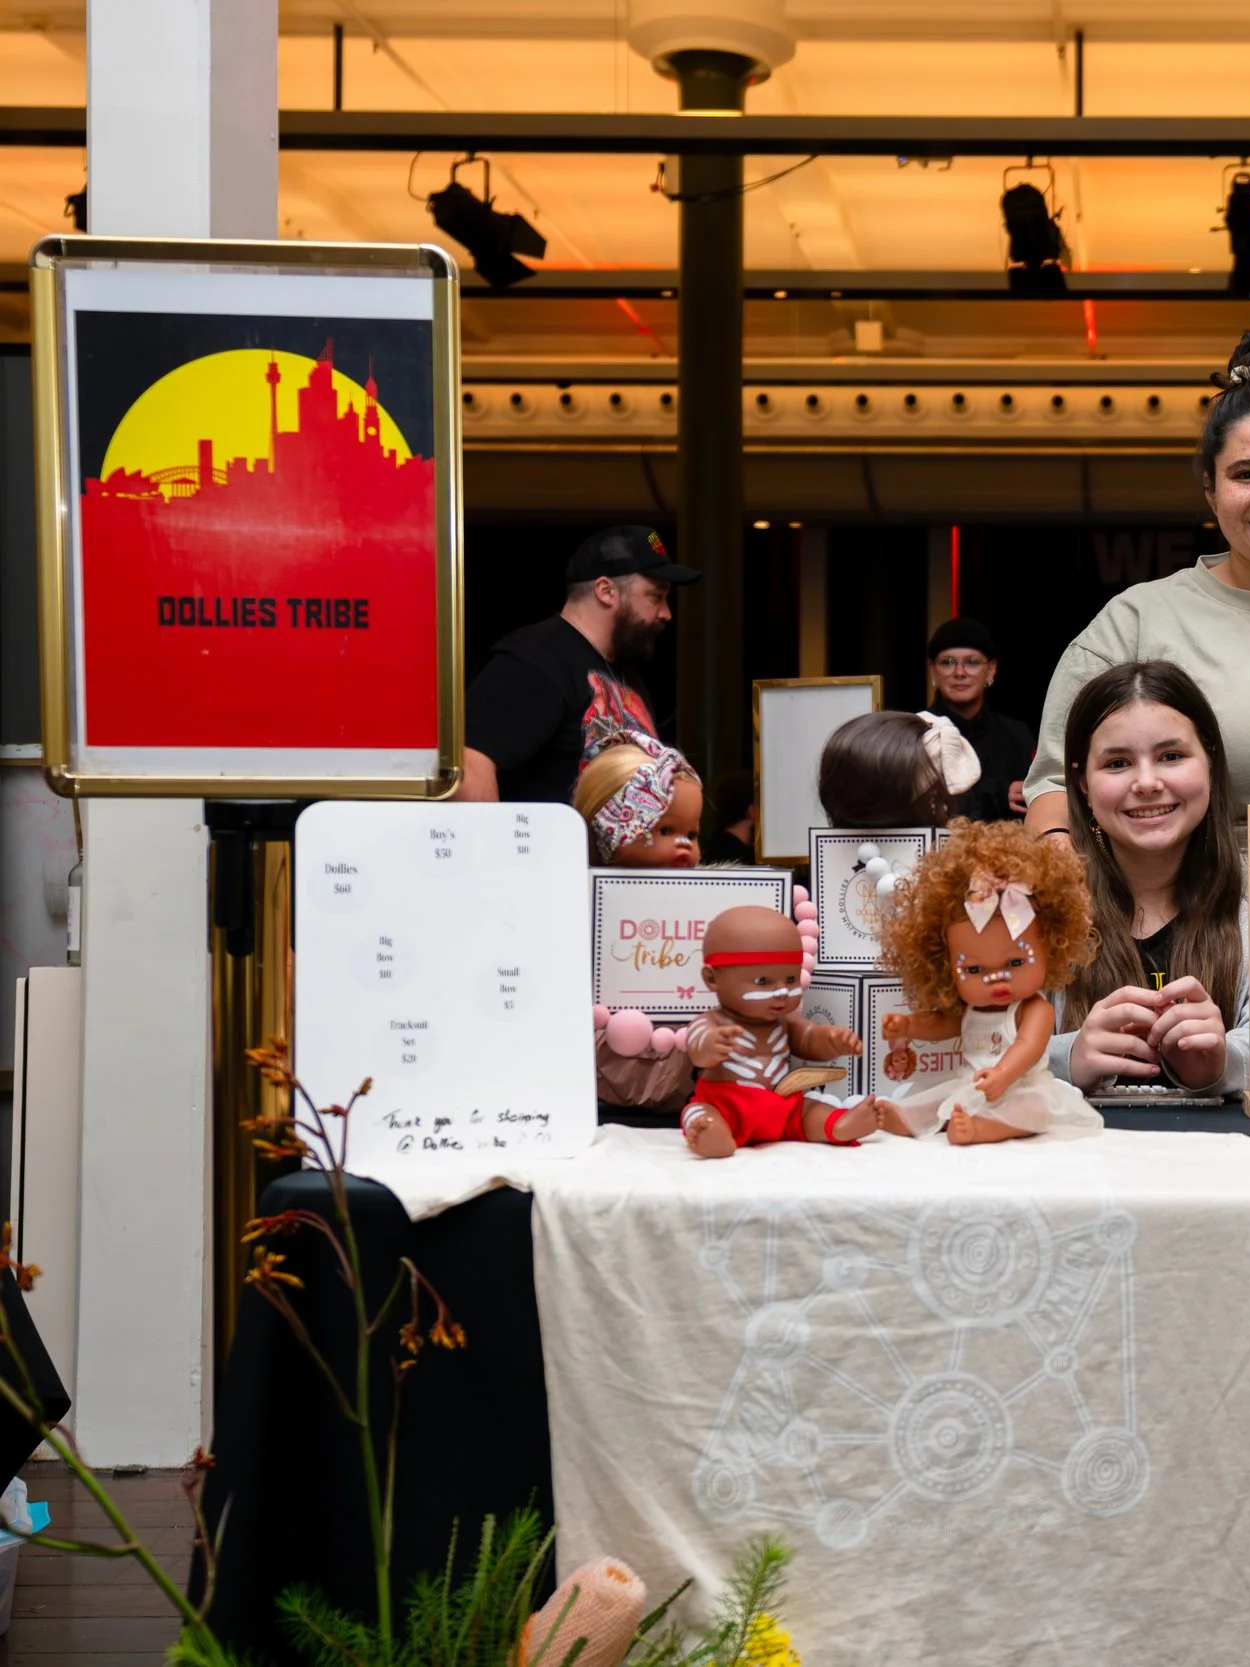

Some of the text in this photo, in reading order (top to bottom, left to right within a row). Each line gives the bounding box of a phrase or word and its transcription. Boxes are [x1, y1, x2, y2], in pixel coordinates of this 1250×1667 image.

[157, 597, 369, 629] DOLLIES TRIBE
[515, 813, 530, 825] Big
[429, 828, 456, 843] Boy's
[513, 829, 531, 839] Bow
[324, 862, 359, 875] Dollies
[333, 883, 351, 895] $60
[619, 919, 705, 940] DOLLIE
[379, 936, 393, 947] Big
[376, 953, 394, 962] Bow
[632, 936, 690, 972] tribe
[497, 966, 520, 977] Small
[499, 984, 517, 993] Bow
[390, 1020, 429, 1030] Tracksuit
[402, 1037, 415, 1047] Set
[919, 1051, 963, 1074] LLIES
